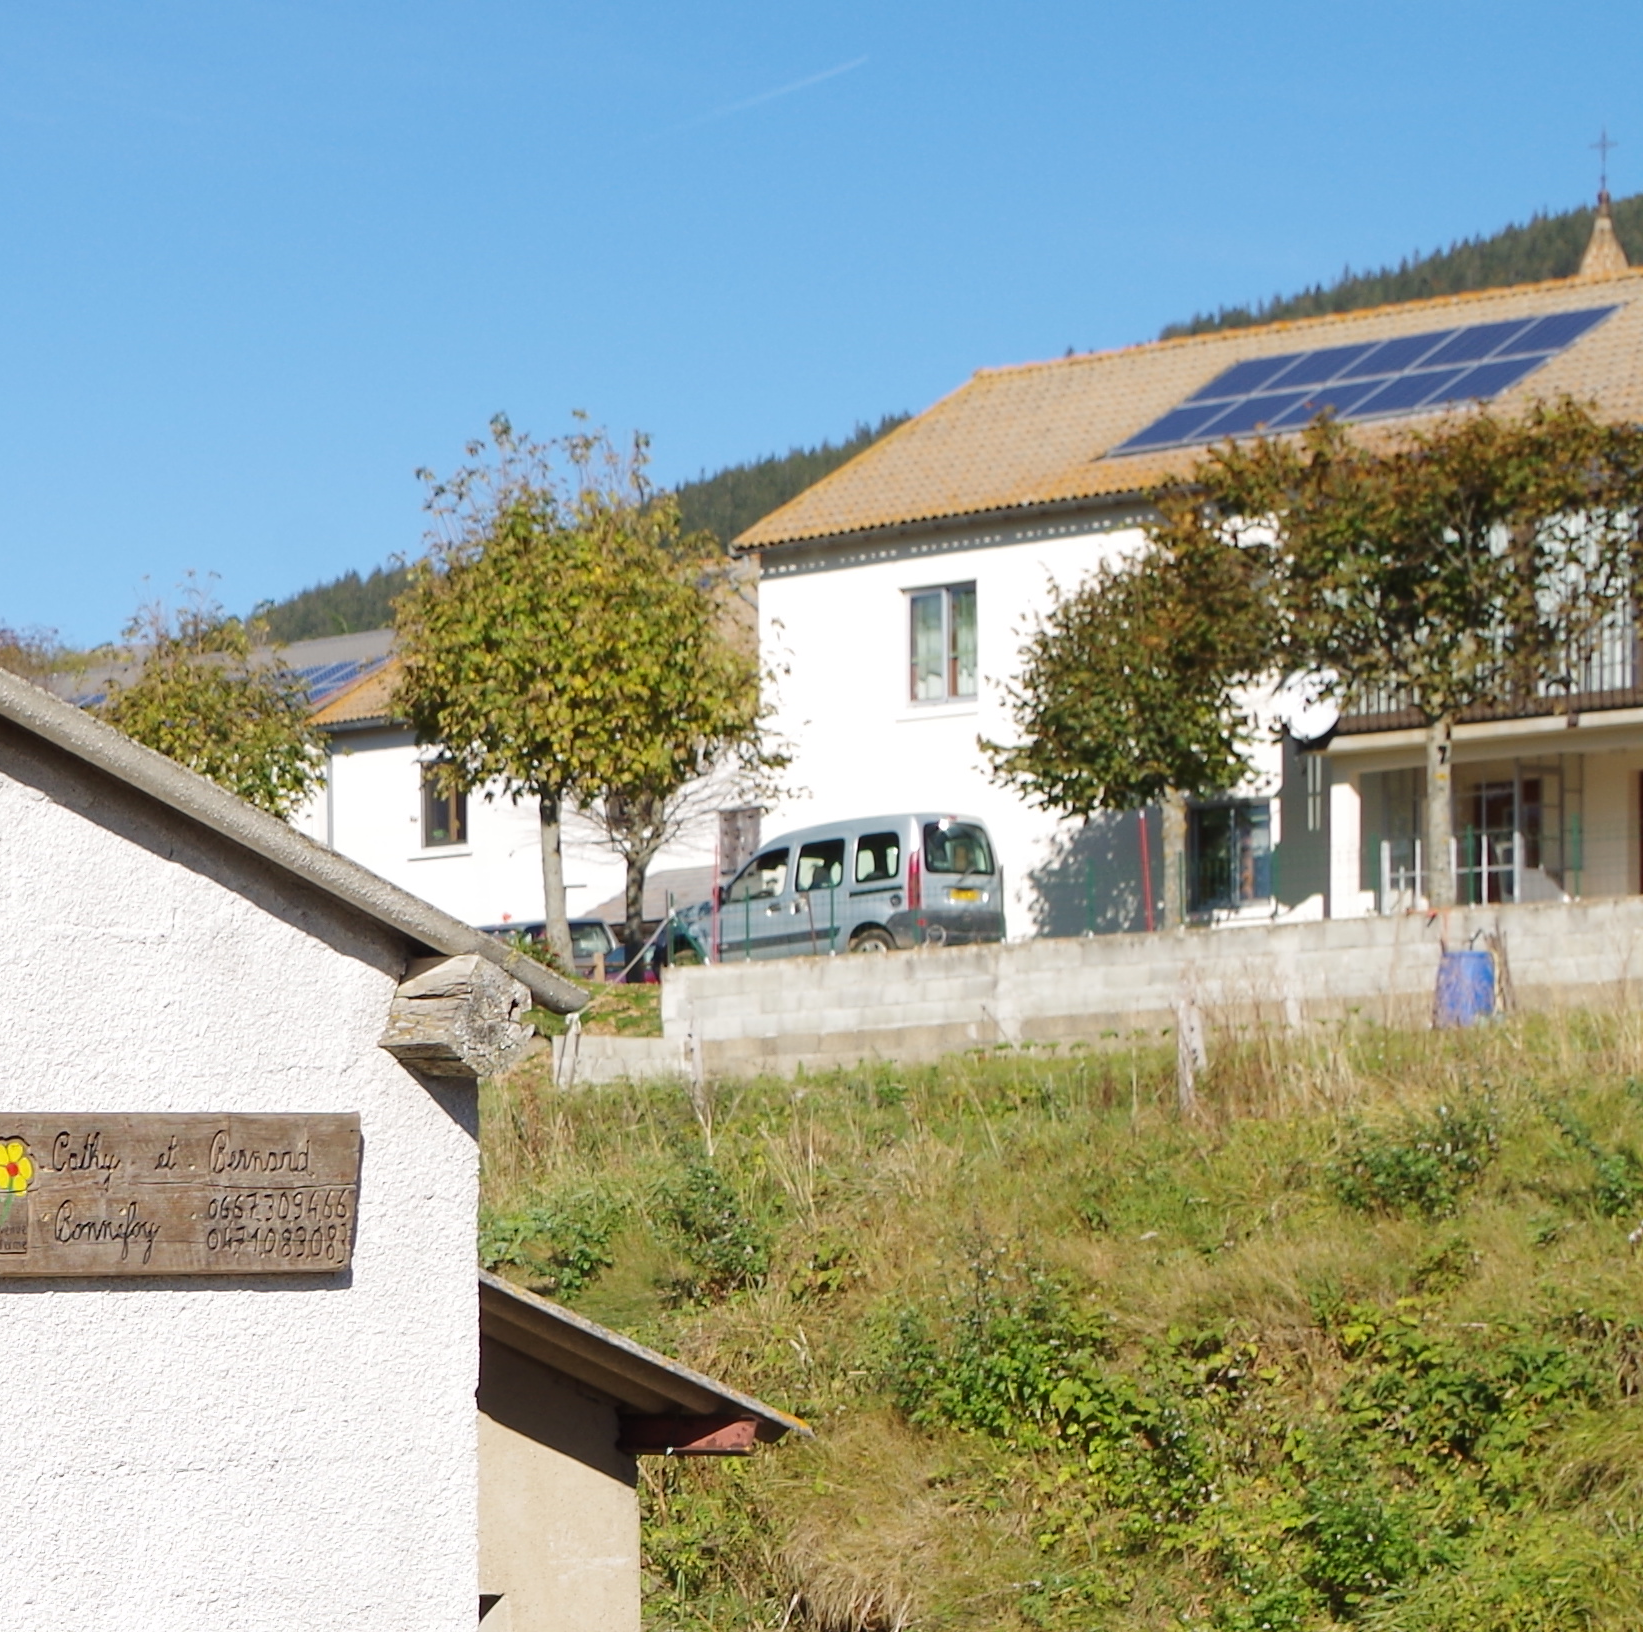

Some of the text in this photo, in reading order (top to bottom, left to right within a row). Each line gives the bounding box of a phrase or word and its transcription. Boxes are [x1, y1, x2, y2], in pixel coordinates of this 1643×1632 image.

[154, 1134, 179, 1171] et
[208, 1188, 350, 1222] 0667309466
[206, 1222, 349, 1264] 0471083083
